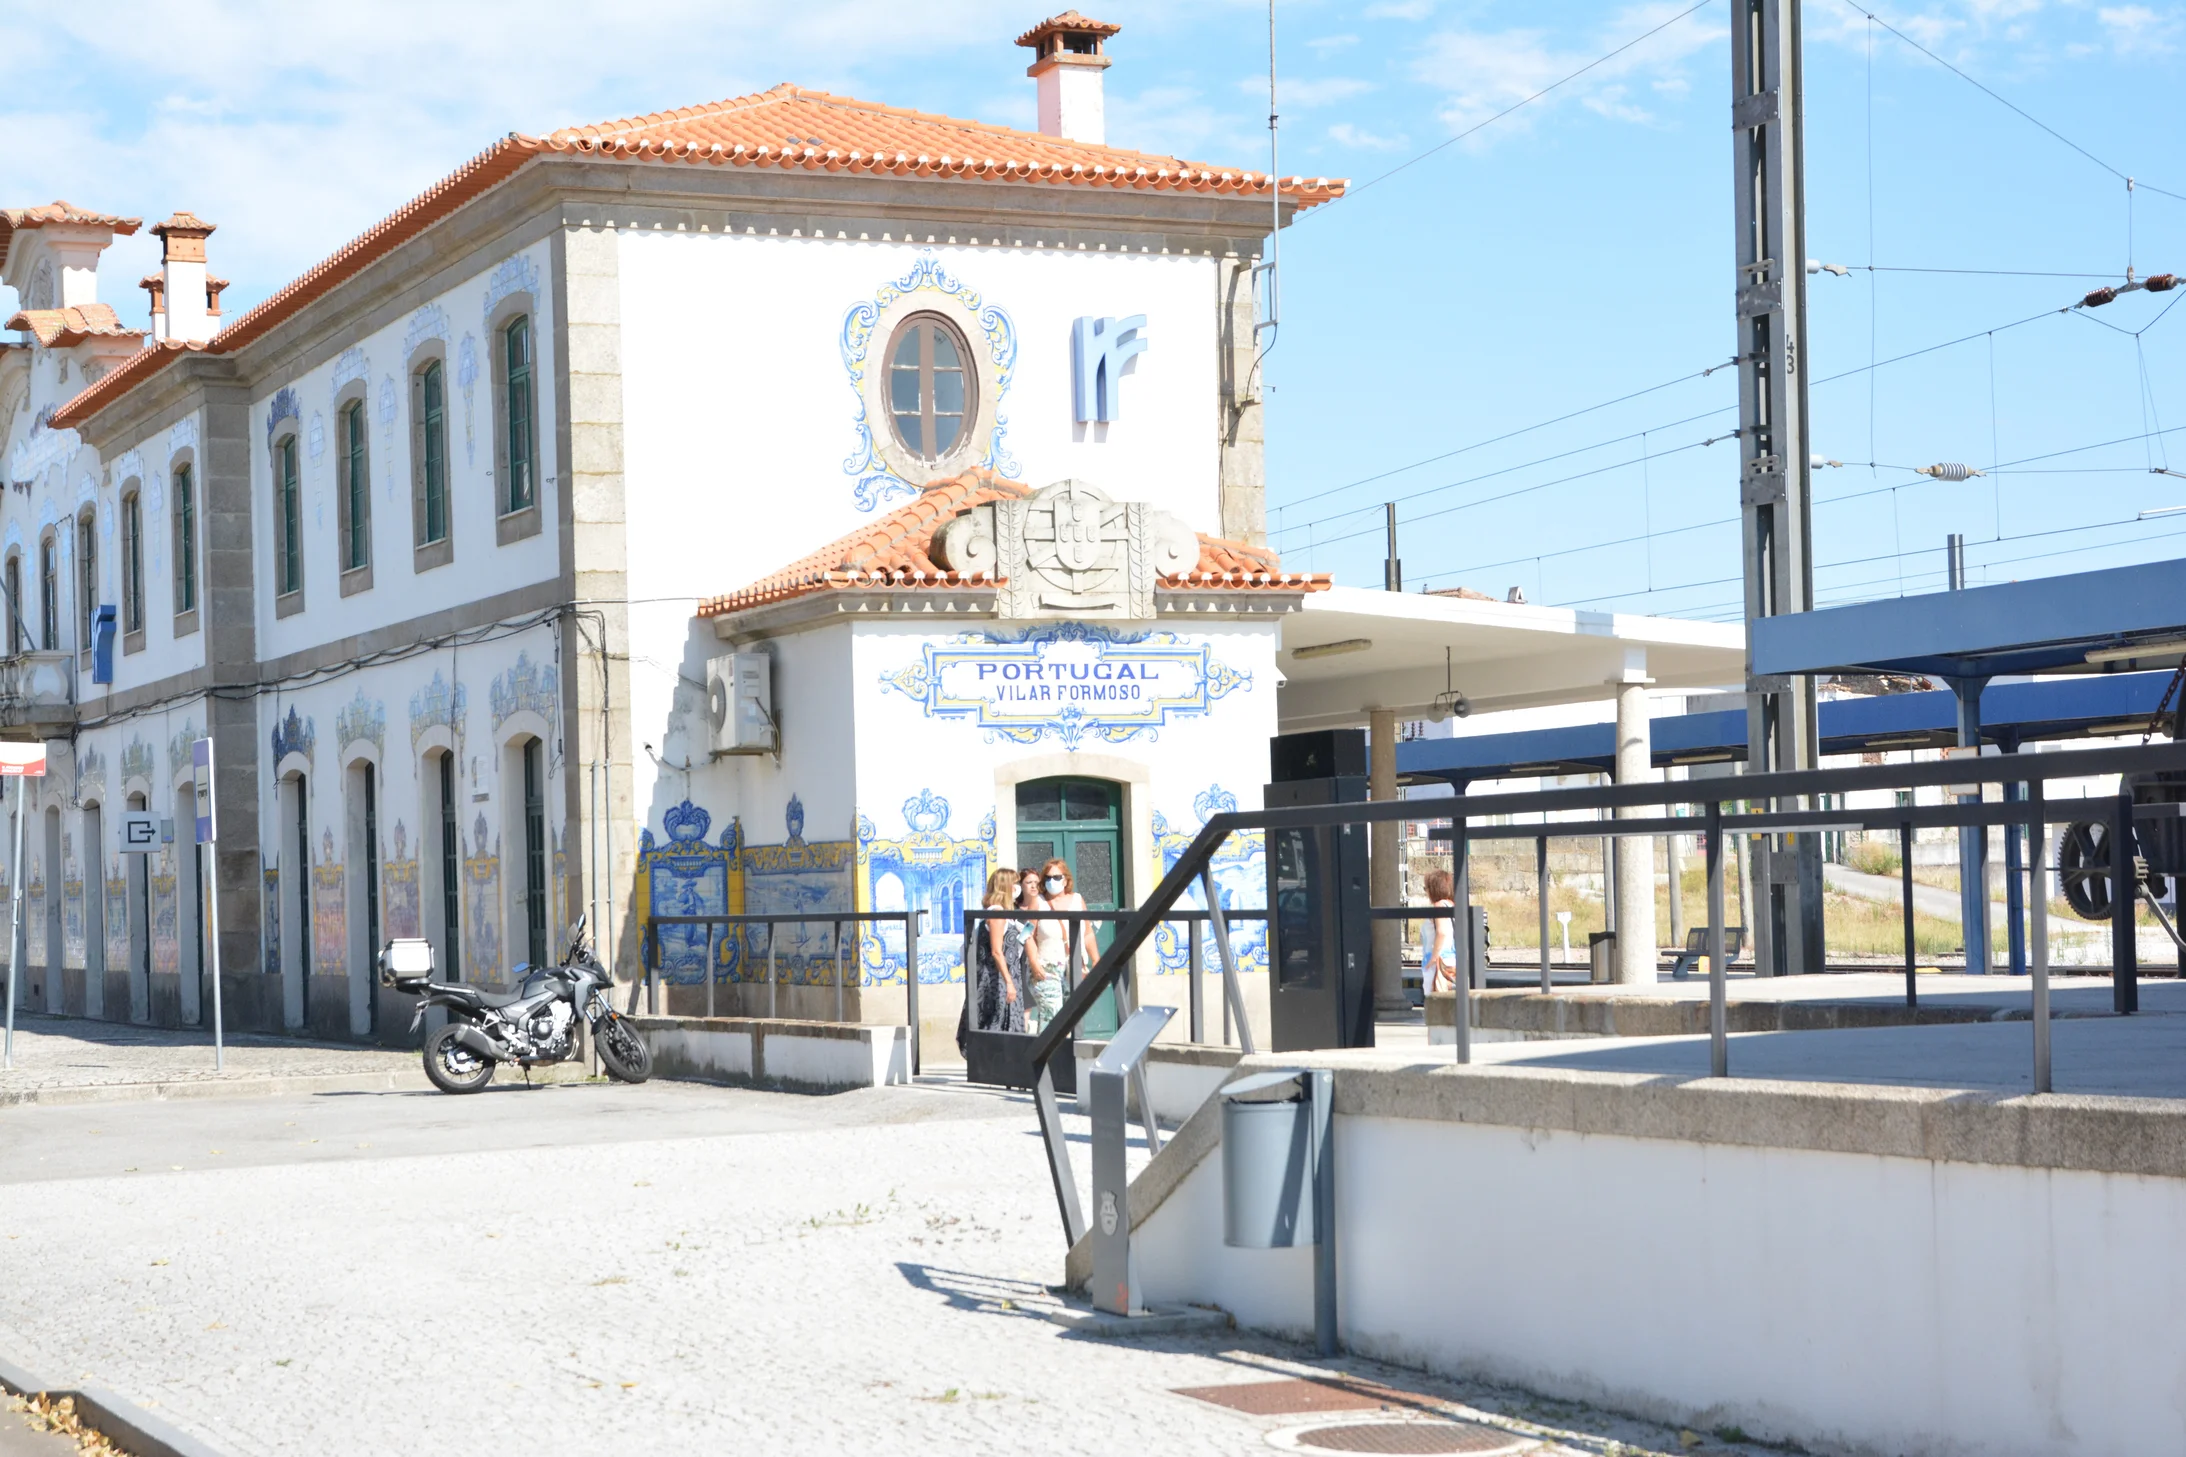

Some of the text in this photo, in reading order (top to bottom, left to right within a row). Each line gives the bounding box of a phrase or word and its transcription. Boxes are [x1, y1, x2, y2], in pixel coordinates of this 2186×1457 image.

[1786, 334, 1795, 374] 43
[976, 662, 1159, 680] PORTUGAL
[996, 684, 1141, 701] VILAR FORMOSO
